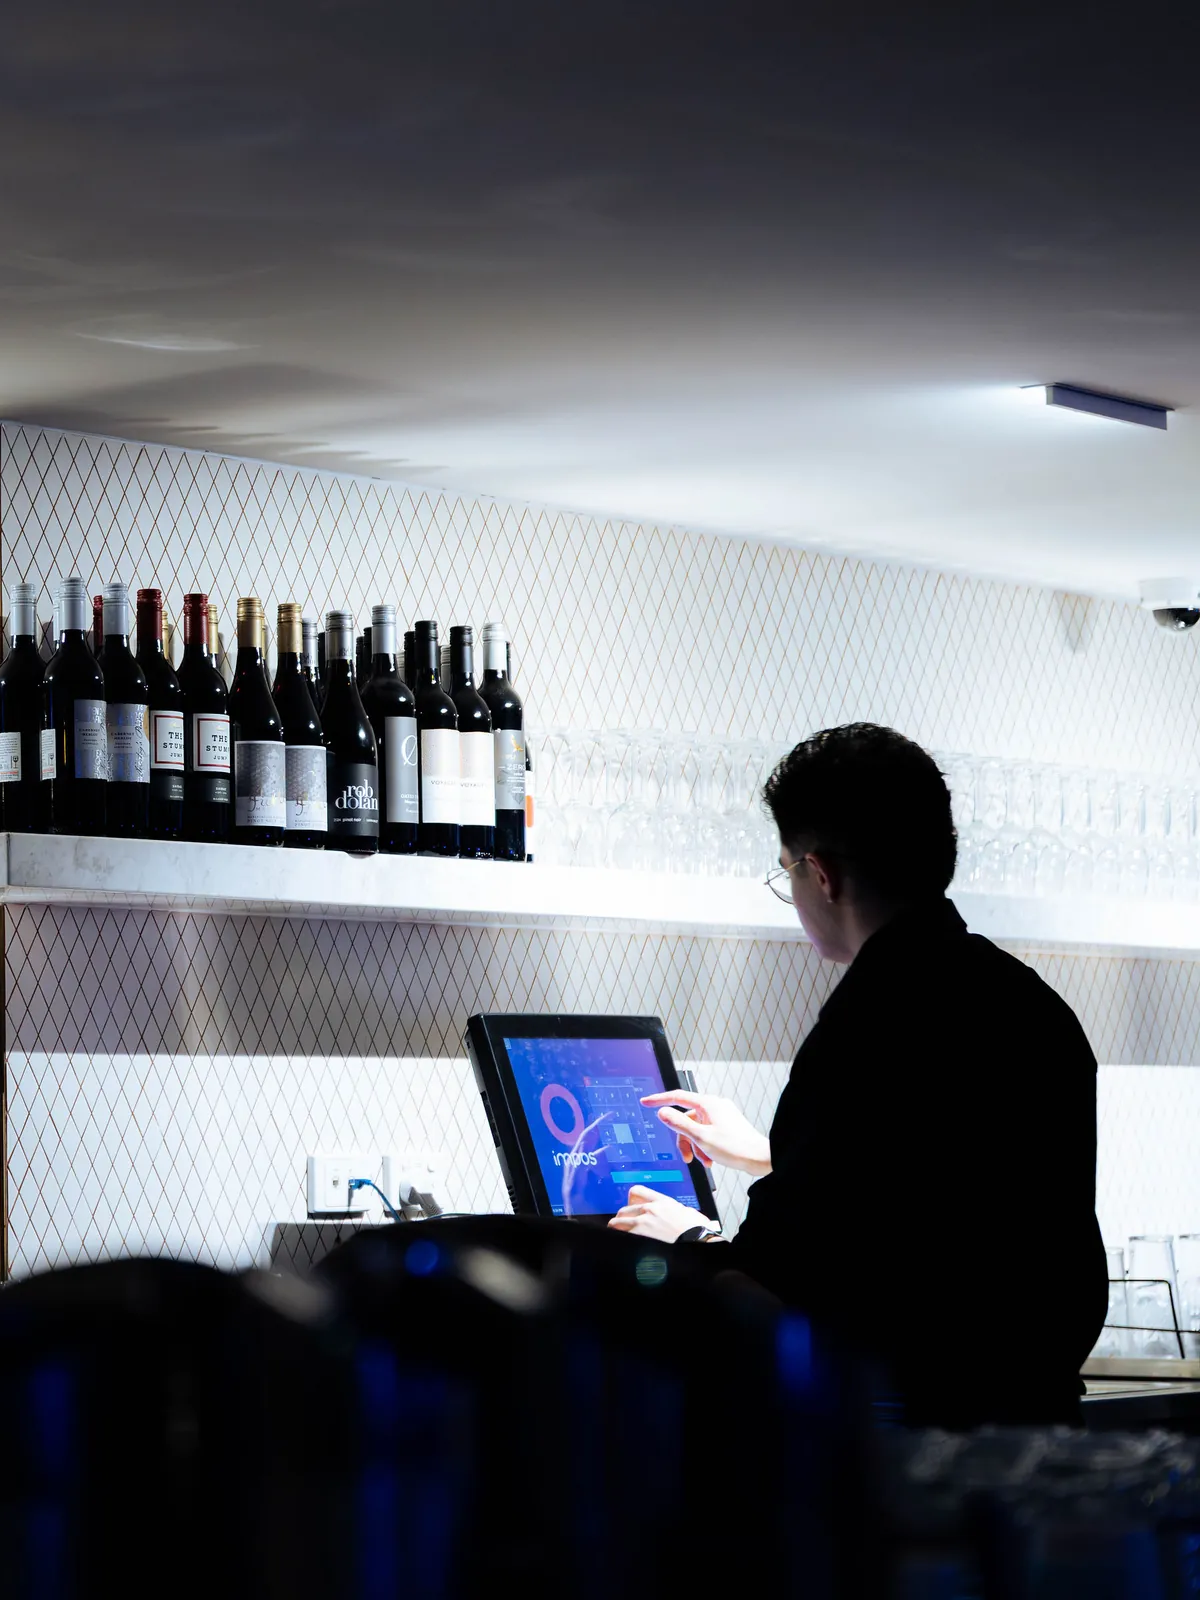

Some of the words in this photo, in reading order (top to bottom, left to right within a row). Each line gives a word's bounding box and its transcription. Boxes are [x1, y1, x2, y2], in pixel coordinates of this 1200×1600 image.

[211, 735, 228, 743] THE
[163, 742, 184, 751] STUM
[205, 745, 229, 753] STUM
[347, 779, 374, 798] rob
[334, 790, 379, 810] dolan
[552, 1150, 598, 1168] impos
